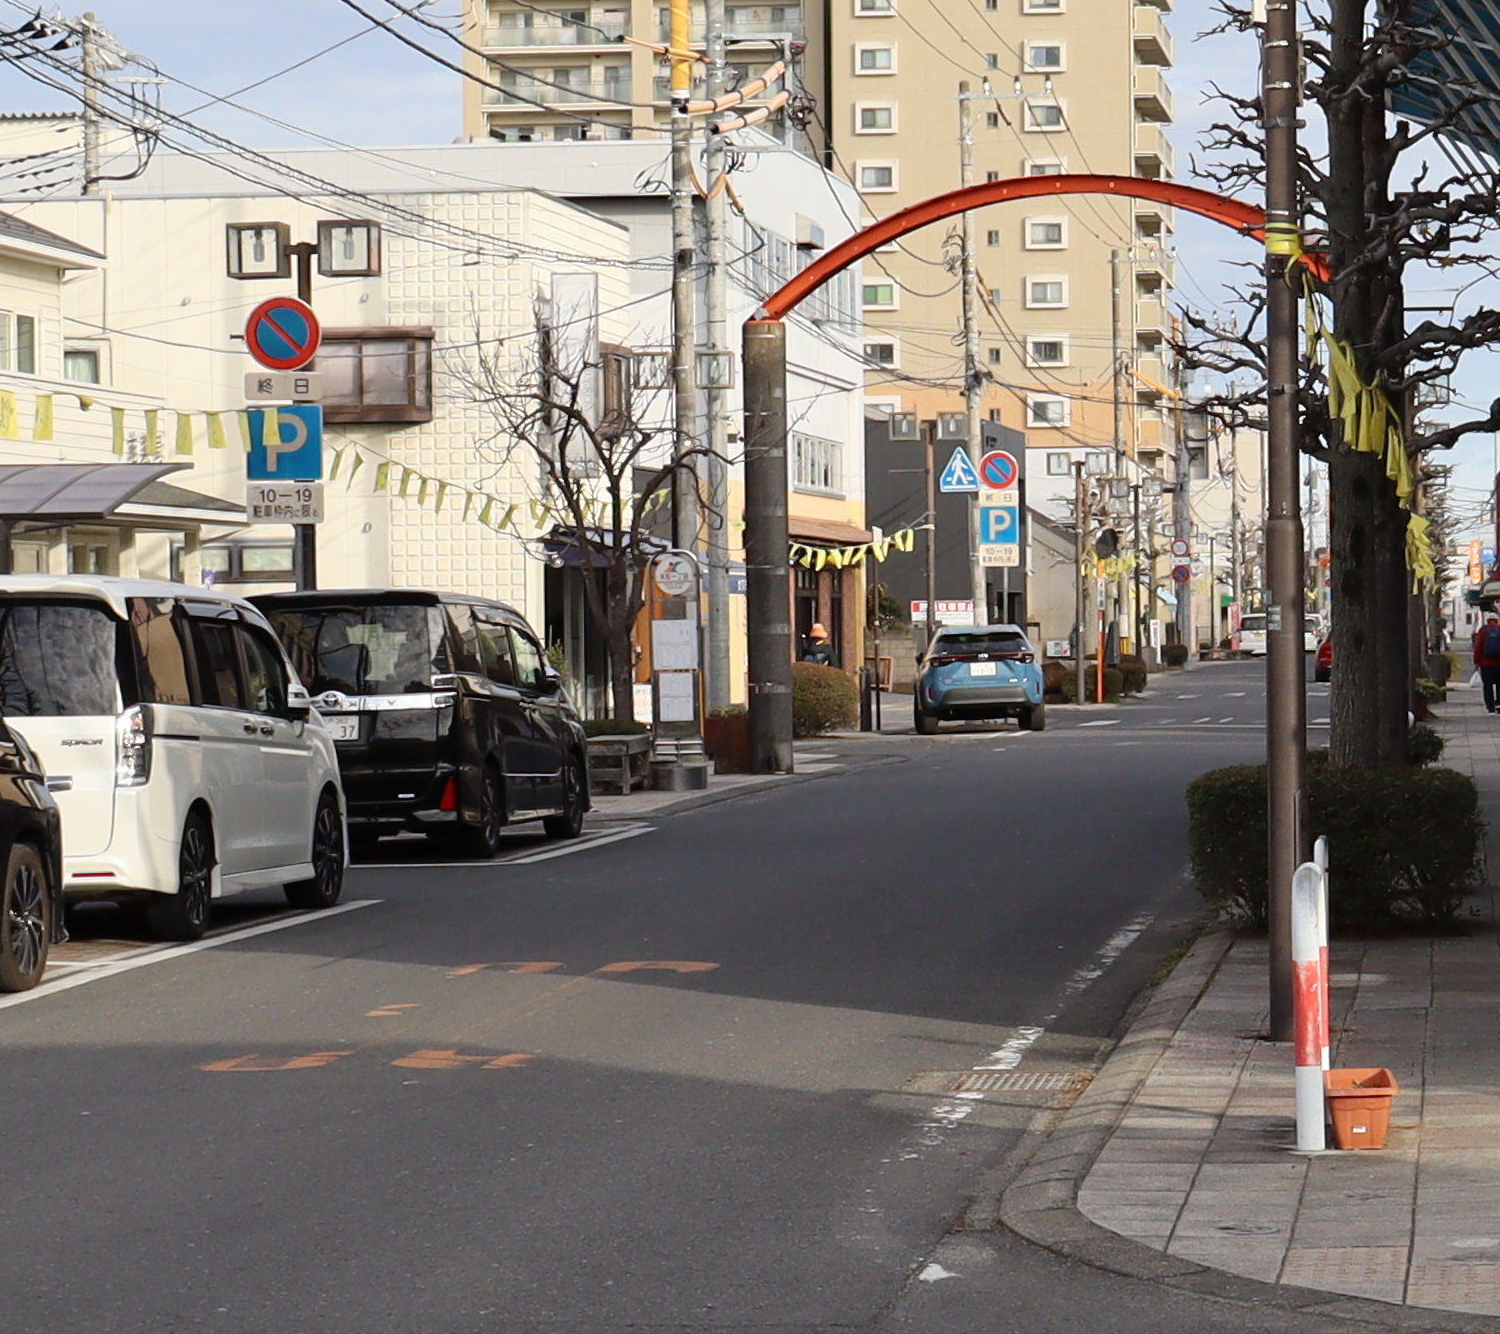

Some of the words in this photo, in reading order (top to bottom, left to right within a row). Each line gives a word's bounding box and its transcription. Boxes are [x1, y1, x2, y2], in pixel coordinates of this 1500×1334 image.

[257, 378, 310, 395] 終日
[266, 413, 308, 473] P
[252, 505, 319, 518] 駐車枠内に限る
[989, 510, 1011, 542] P
